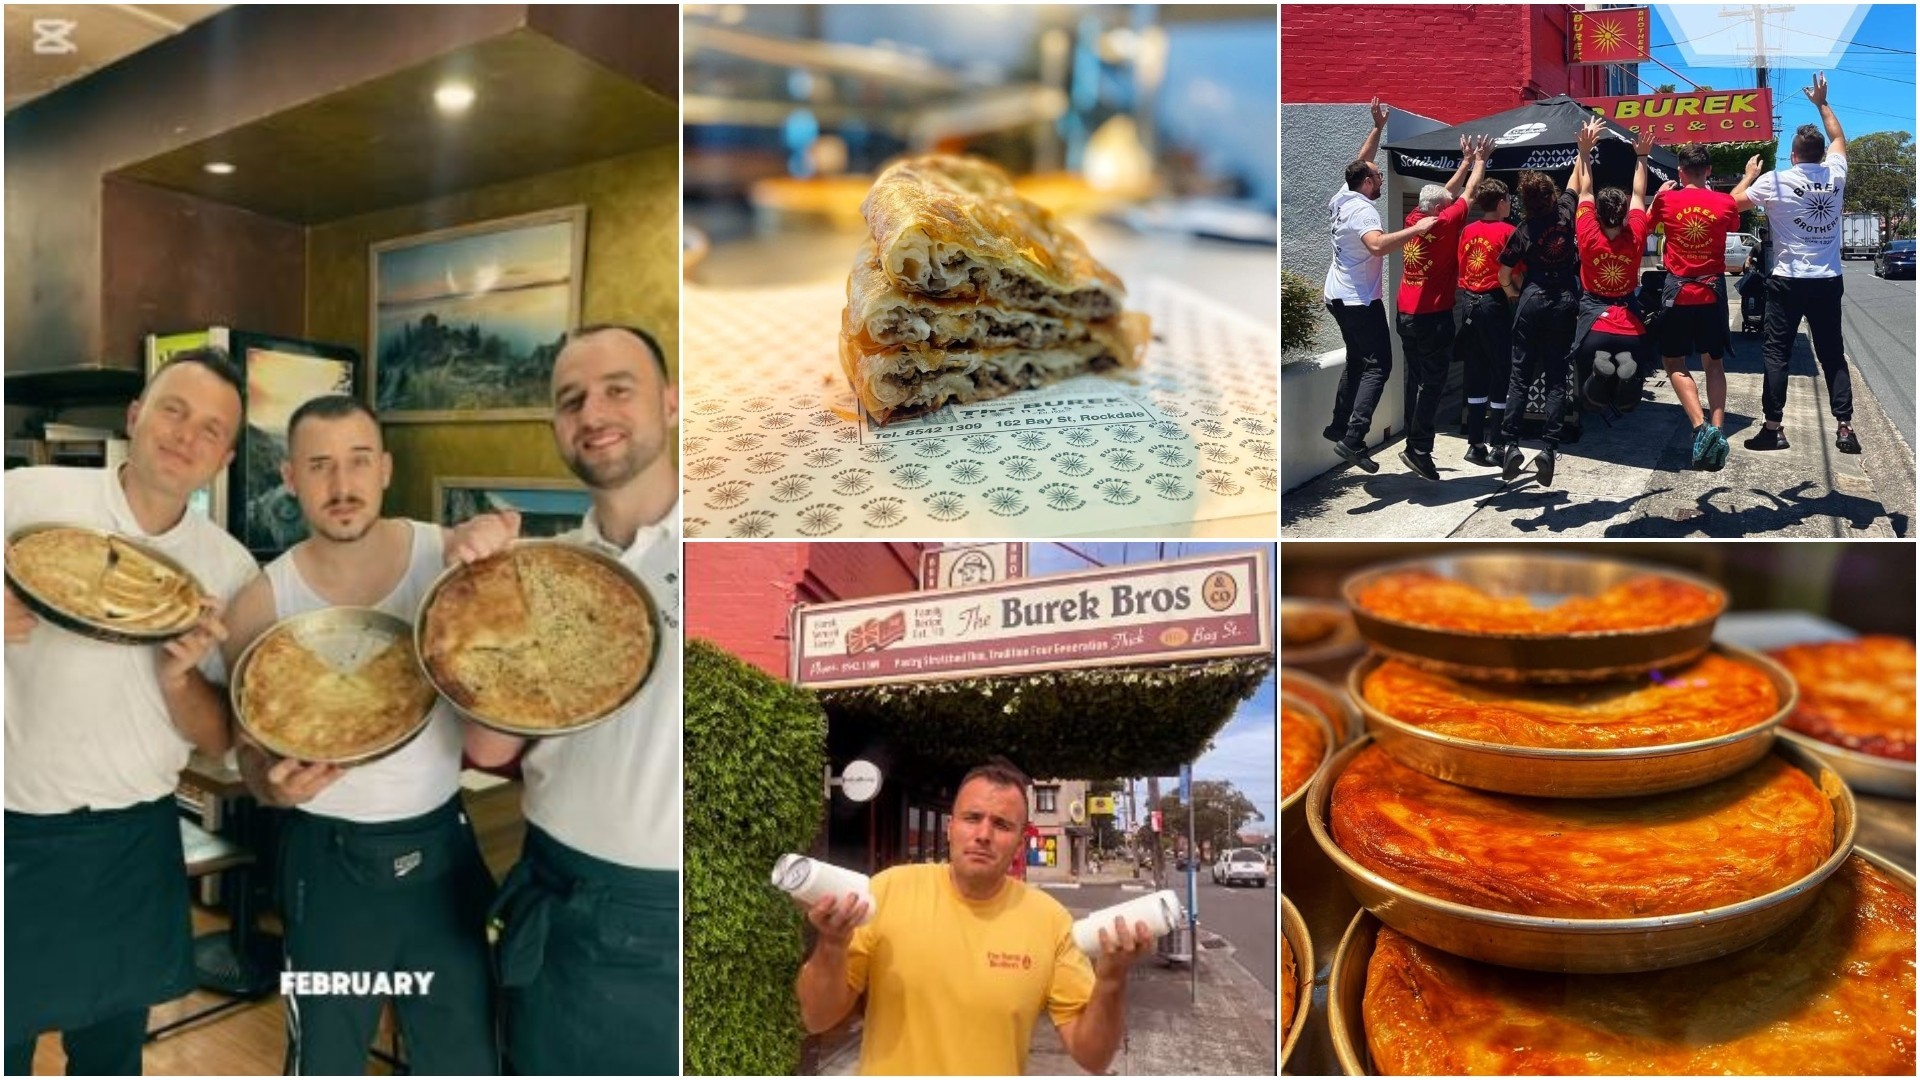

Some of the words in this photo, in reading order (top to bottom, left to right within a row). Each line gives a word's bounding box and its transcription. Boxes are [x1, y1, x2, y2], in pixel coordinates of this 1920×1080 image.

[1573, 14, 1583, 60] BUREK
[1637, 10, 1645, 57] BROTHERS
[1615, 93, 1759, 119] BUREK
[1687, 121, 1706, 131] &
[1720, 119, 1760, 129] Co.
[1675, 207, 1717, 222] BUREK
[1465, 237, 1493, 252] BUREK
[1593, 252, 1632, 266] BUREK
[960, 407, 1015, 416] The
[1023, 397, 1124, 409] BUREK
[874, 432, 900, 440] Tel.
[905, 427, 942, 436] 8542
[947, 423, 983, 432] 1309
[996, 419, 1021, 428] 162
[1025, 416, 1053, 426] Bay
[1057, 415, 1077, 424] St,
[1080, 410, 1145, 422] Rockdale
[1214, 576, 1225, 588] &
[1210, 590, 1232, 603] CO
[957, 605, 991, 637] The
[1002, 589, 1100, 628] Burek
[1111, 584, 1191, 618] Bros
[1192, 627, 1218, 646] Bay
[1222, 621, 1241, 639] St.
